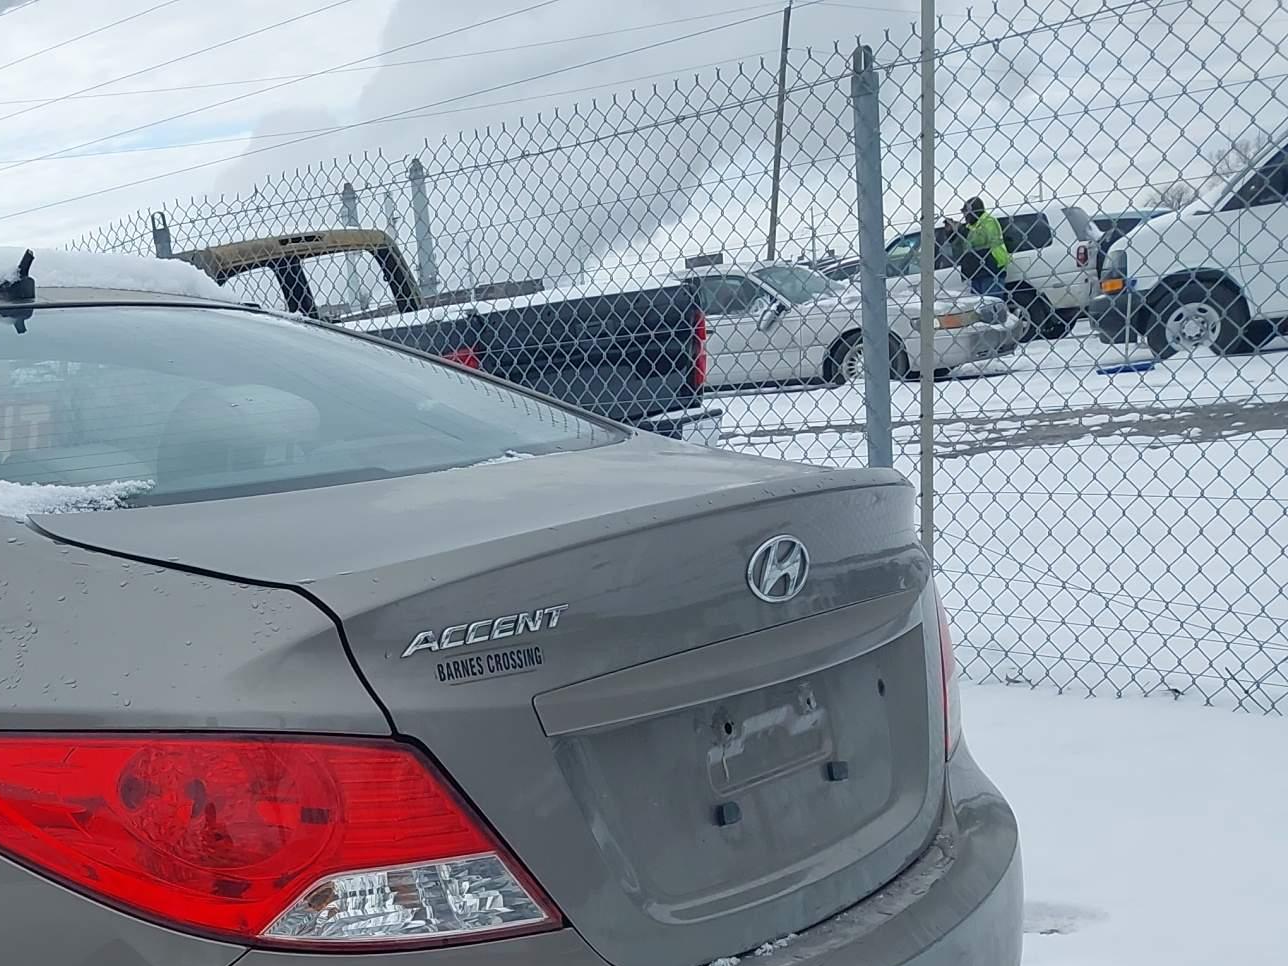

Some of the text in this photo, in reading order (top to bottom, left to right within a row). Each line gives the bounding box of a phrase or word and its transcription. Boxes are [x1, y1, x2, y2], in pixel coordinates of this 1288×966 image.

[400, 603, 569, 659] ACCENT
[436, 646, 543, 682] BARNES CROSSING
